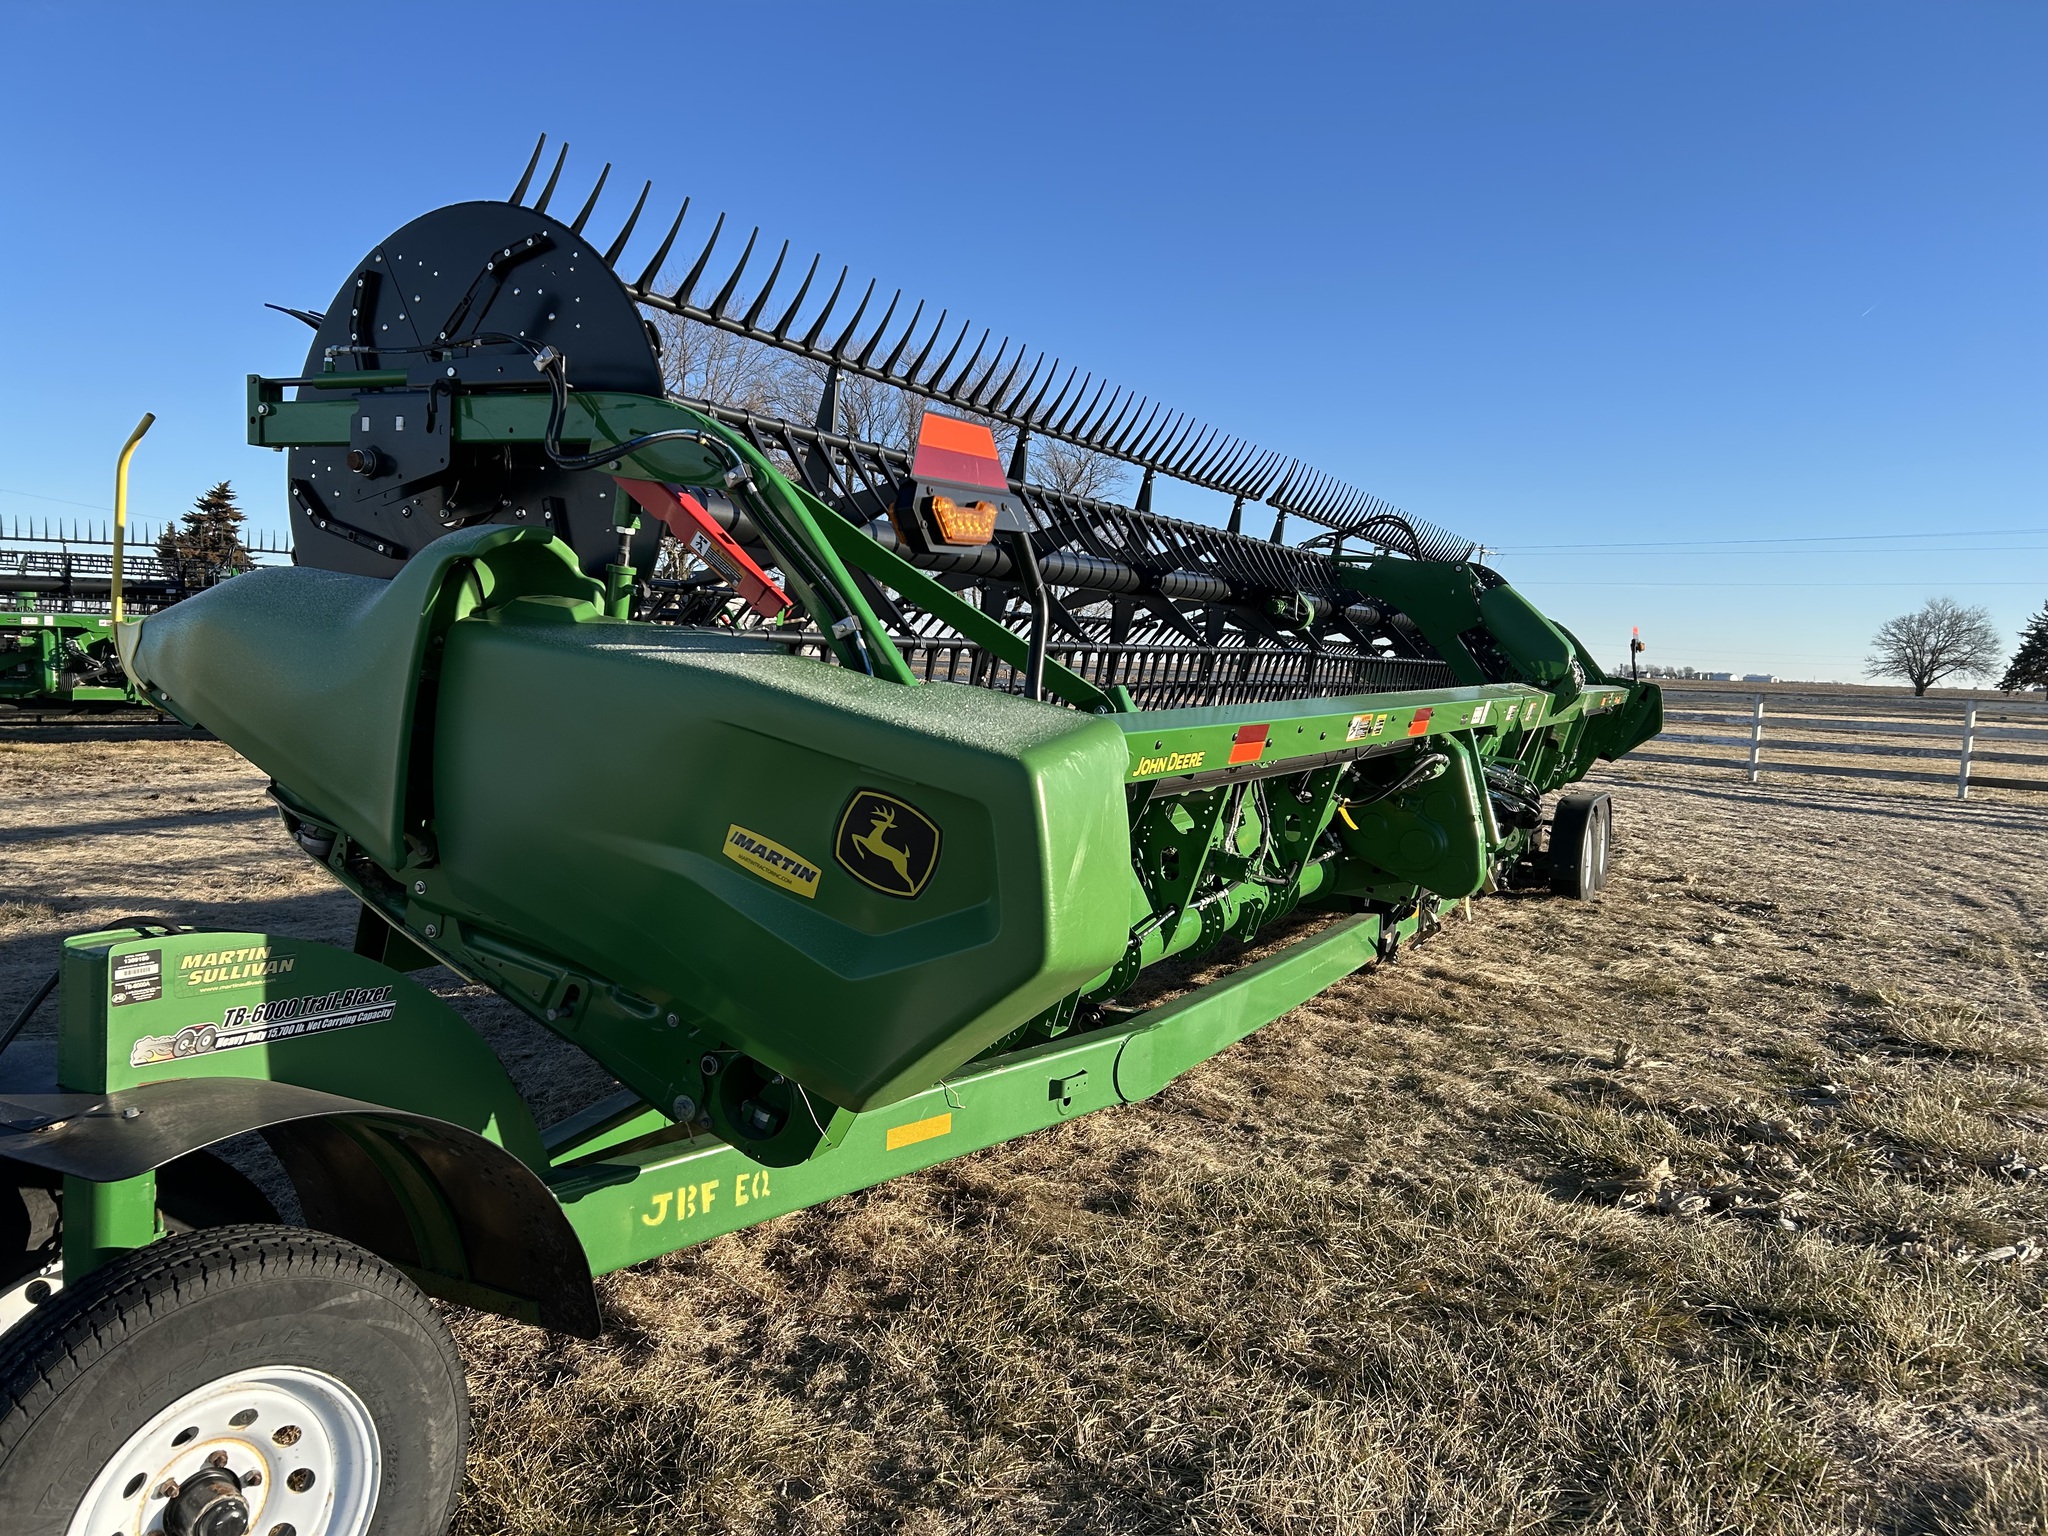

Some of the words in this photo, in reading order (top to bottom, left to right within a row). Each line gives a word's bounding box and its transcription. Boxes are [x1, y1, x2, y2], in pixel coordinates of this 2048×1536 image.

[1132, 756, 1168, 777] JOHN
[1166, 751, 1206, 772] DEERE
[733, 832, 818, 883] MARTIN
[180, 946, 272, 970] MARTIN
[187, 959, 295, 986] SULLIVAN
[199, 978, 276, 993] www.martinsullivan.com
[223, 998, 299, 1028] TB-6000
[299, 985, 393, 1015] Trail-Blazer
[216, 1035, 246, 1049] Heavy
[245, 1031, 267, 1043] Duty
[267, 1026, 296, 1039] 15,700
[294, 1023, 305, 1034] lb.
[306, 1021, 322, 1032] Net
[321, 1015, 356, 1029] Carrying
[357, 1008, 393, 1022] Capacity
[642, 1180, 720, 1227] JBF
[735, 1171, 772, 1206] EQ
